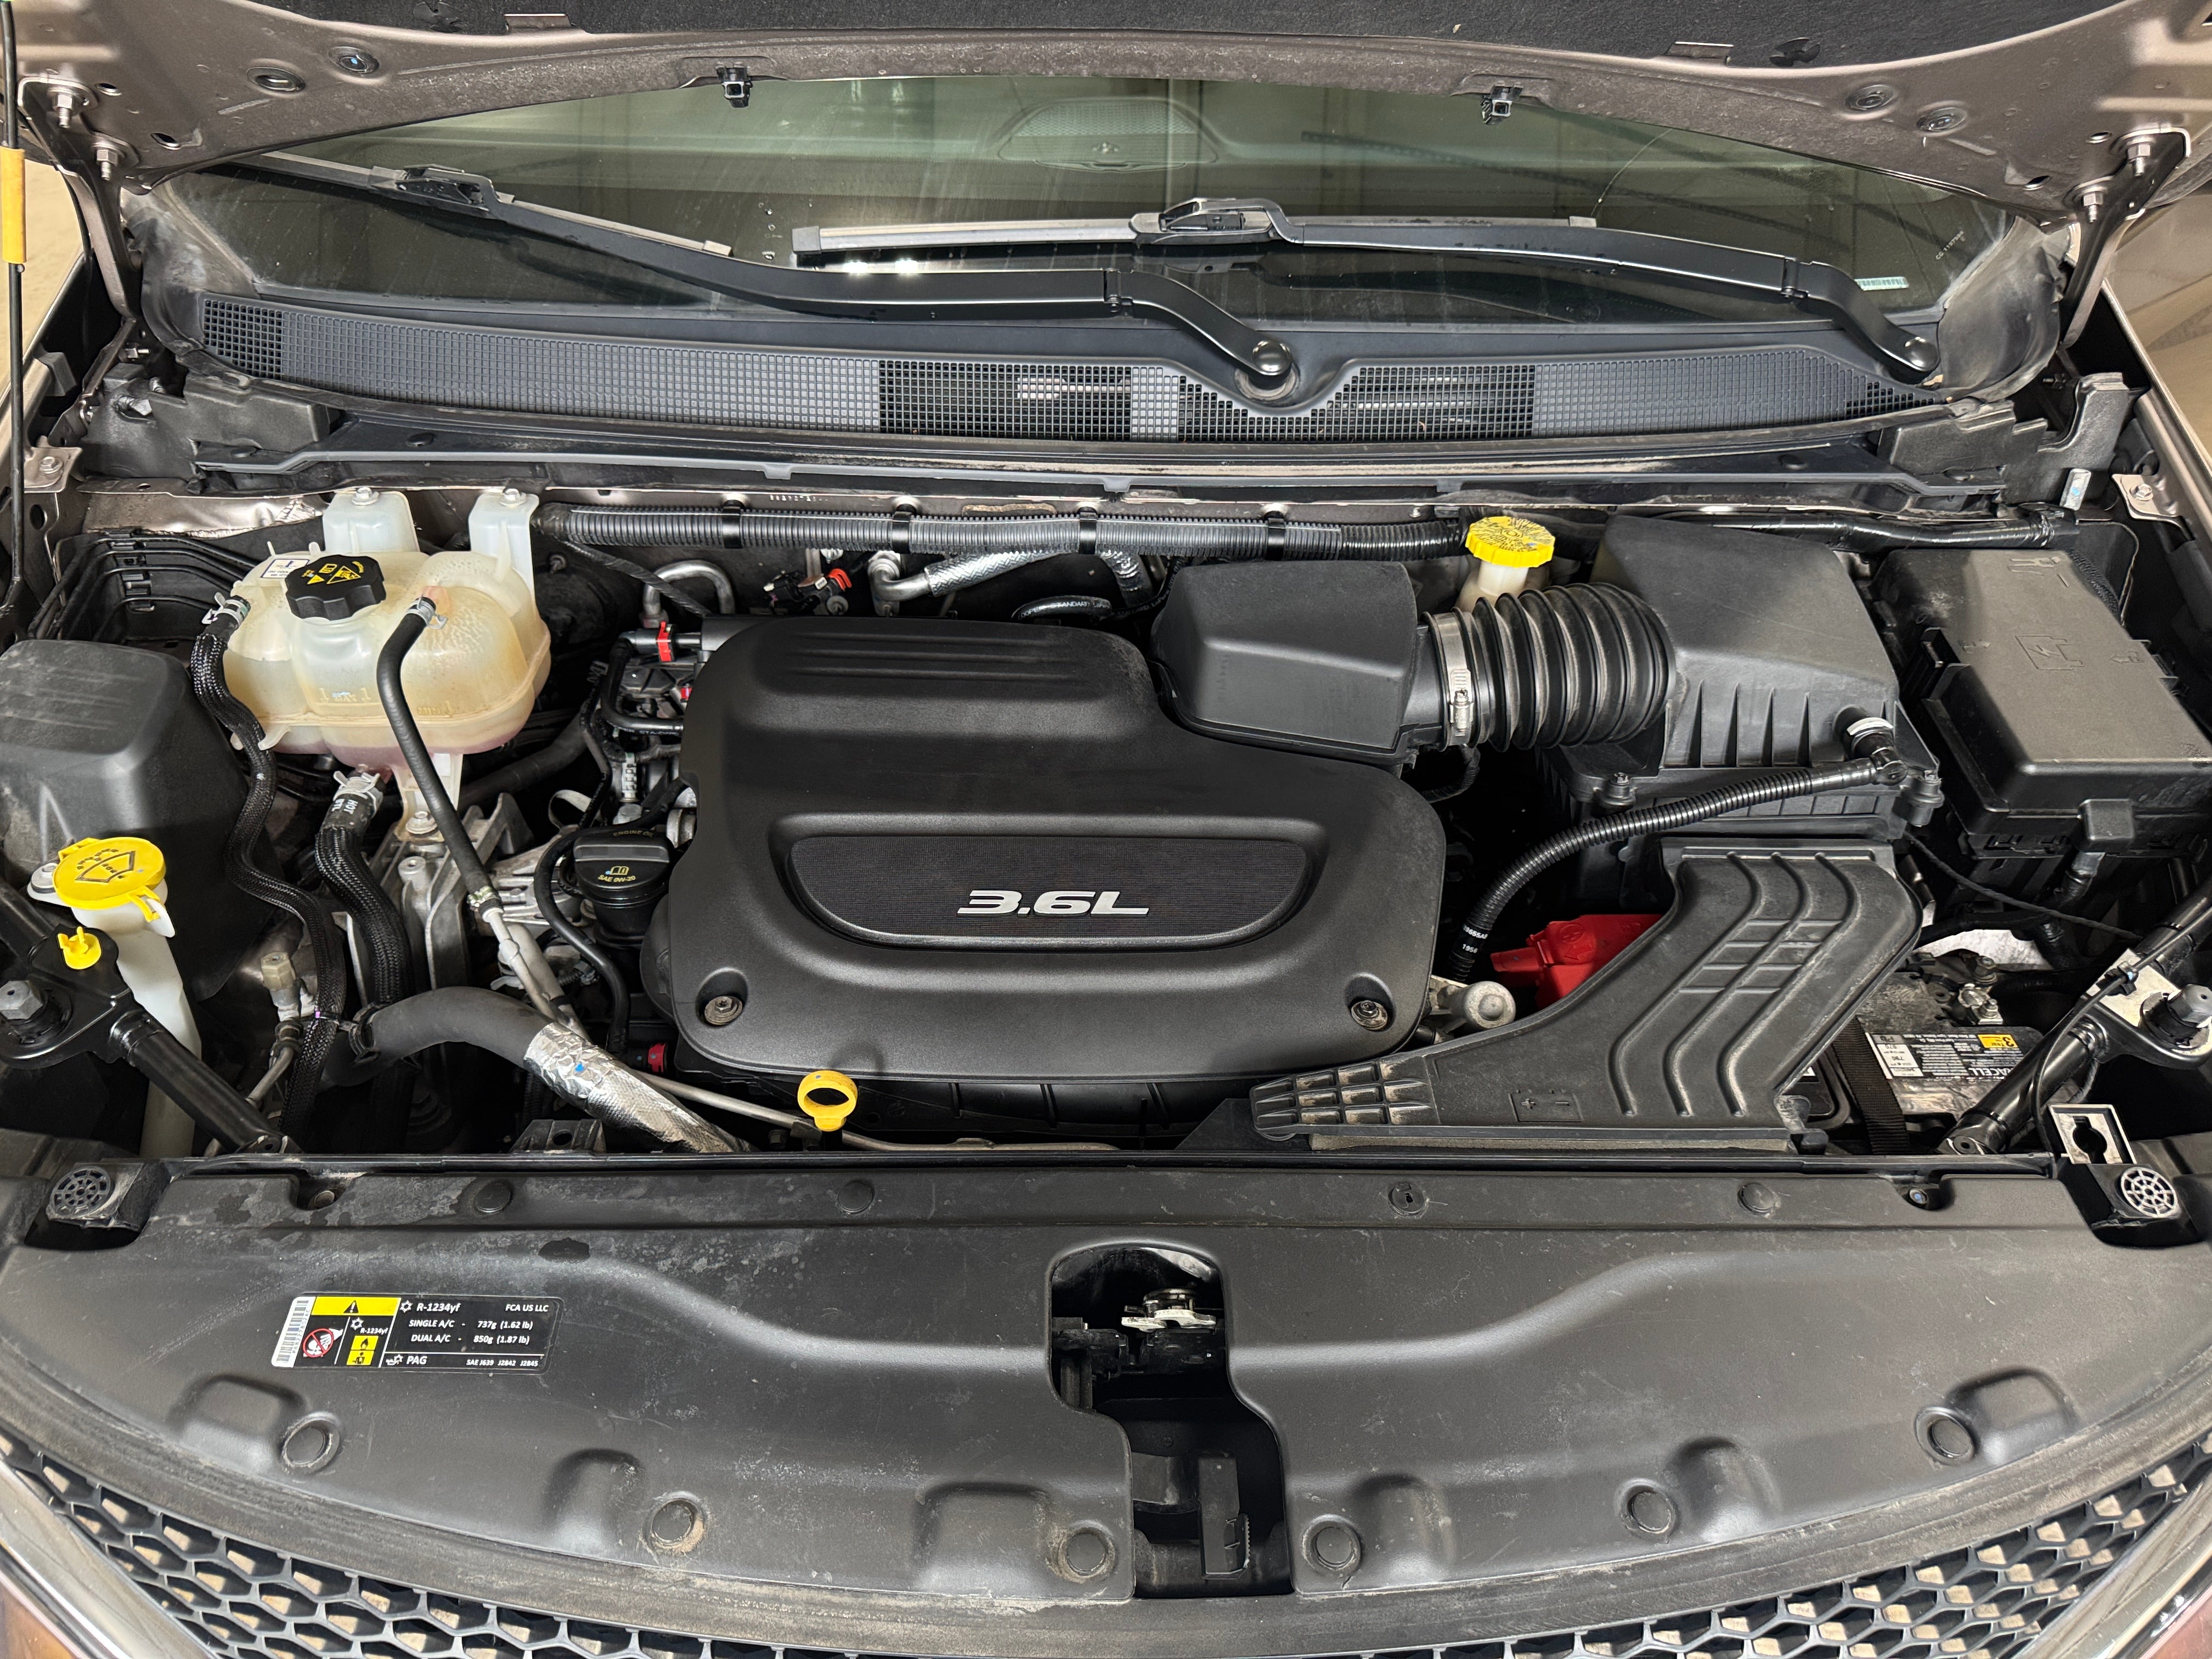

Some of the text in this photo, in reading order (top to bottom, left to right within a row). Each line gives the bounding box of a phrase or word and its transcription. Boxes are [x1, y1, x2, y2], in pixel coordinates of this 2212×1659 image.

[343, 799, 359, 815] HOT
[957, 889, 1150, 918] 3.6L
[416, 1302, 461, 1313] R-1234yf
[438, 1319, 455, 1328] A/C
[477, 1321, 496, 1329] 737g
[500, 1321, 521, 1330] (1.62
[522, 1321, 533, 1330] lb)
[360, 1327, 389, 1335] R-1234yf
[434, 1334, 451, 1342] A/C
[473, 1335, 493, 1344] 850g
[496, 1335, 517, 1344] (1.87
[518, 1335, 530, 1345] lb)
[407, 1356, 427, 1365] PAG
